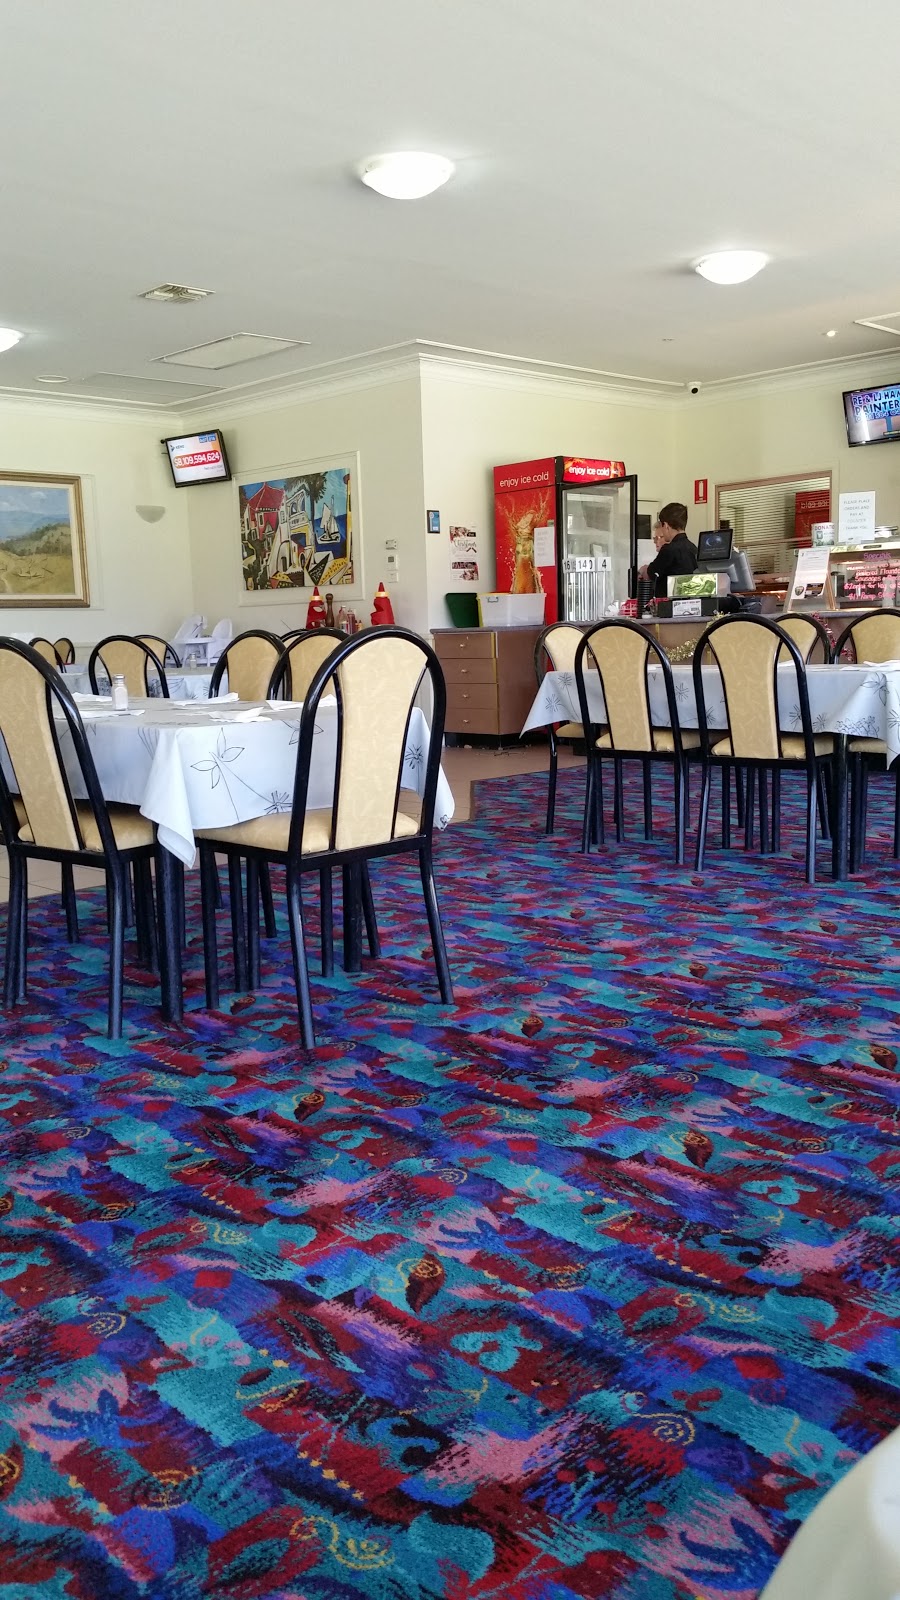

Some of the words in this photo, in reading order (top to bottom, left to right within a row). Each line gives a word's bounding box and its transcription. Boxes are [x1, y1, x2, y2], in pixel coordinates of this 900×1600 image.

[852, 396, 863, 406] RE
[568, 466, 586, 476] enjoy
[586, 466, 597, 475] ice
[596, 467, 610, 476] cold
[499, 478, 519, 488] enjoy
[520, 476, 531, 484] ice
[532, 471, 549, 482] cold
[563, 560, 571, 570] 16
[601, 559, 607, 569] 4
